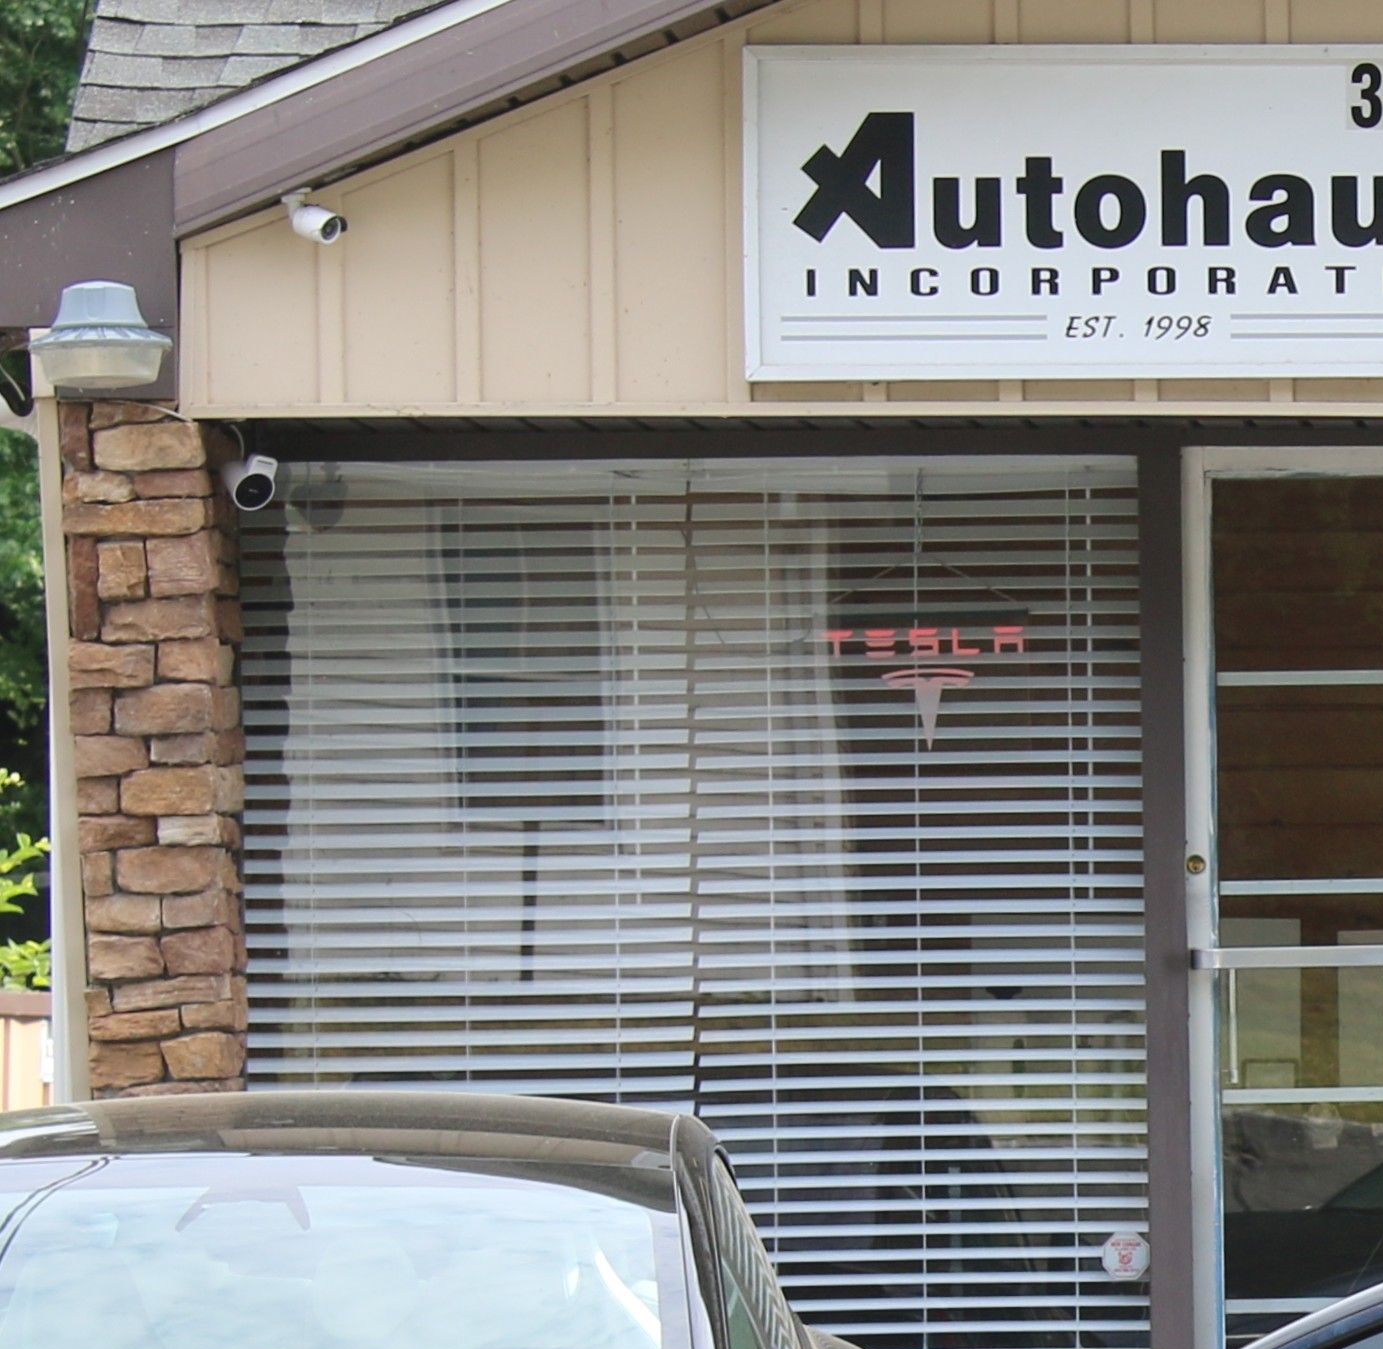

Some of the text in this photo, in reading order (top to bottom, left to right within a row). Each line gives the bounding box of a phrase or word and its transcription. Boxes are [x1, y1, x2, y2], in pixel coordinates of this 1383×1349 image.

[1065, 314, 1212, 340] EST. 1998
[821, 625, 1025, 659] TESLA
